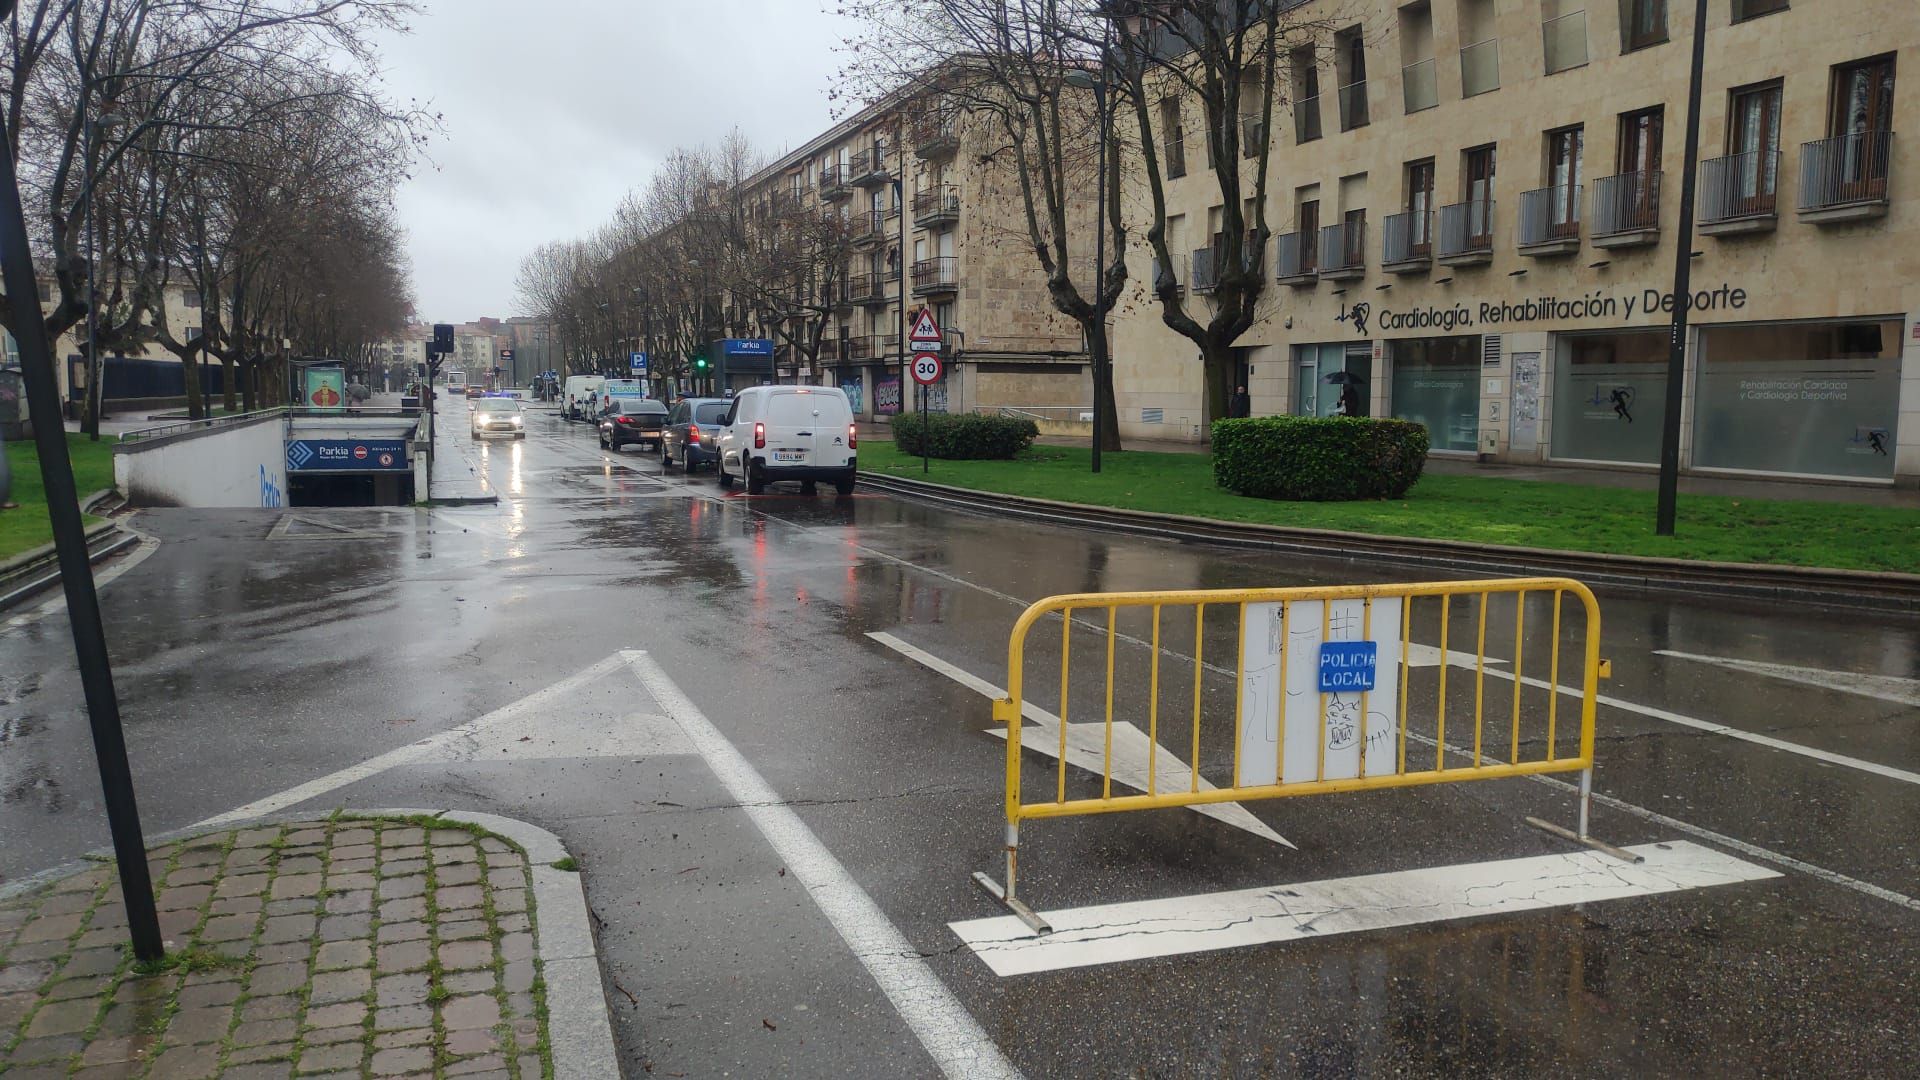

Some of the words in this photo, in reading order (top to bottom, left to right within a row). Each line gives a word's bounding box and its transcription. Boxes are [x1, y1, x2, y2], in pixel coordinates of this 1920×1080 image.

[1379, 303, 1473, 331] Cardiología,
[1479, 291, 1615, 324] Rehabilitación
[1623, 296, 1636, 320] y
[918, 363, 935, 374] 30
[319, 446, 349, 456] Parkia
[1320, 653, 1376, 668] POLICIA
[1322, 671, 1372, 687] LOCAL
